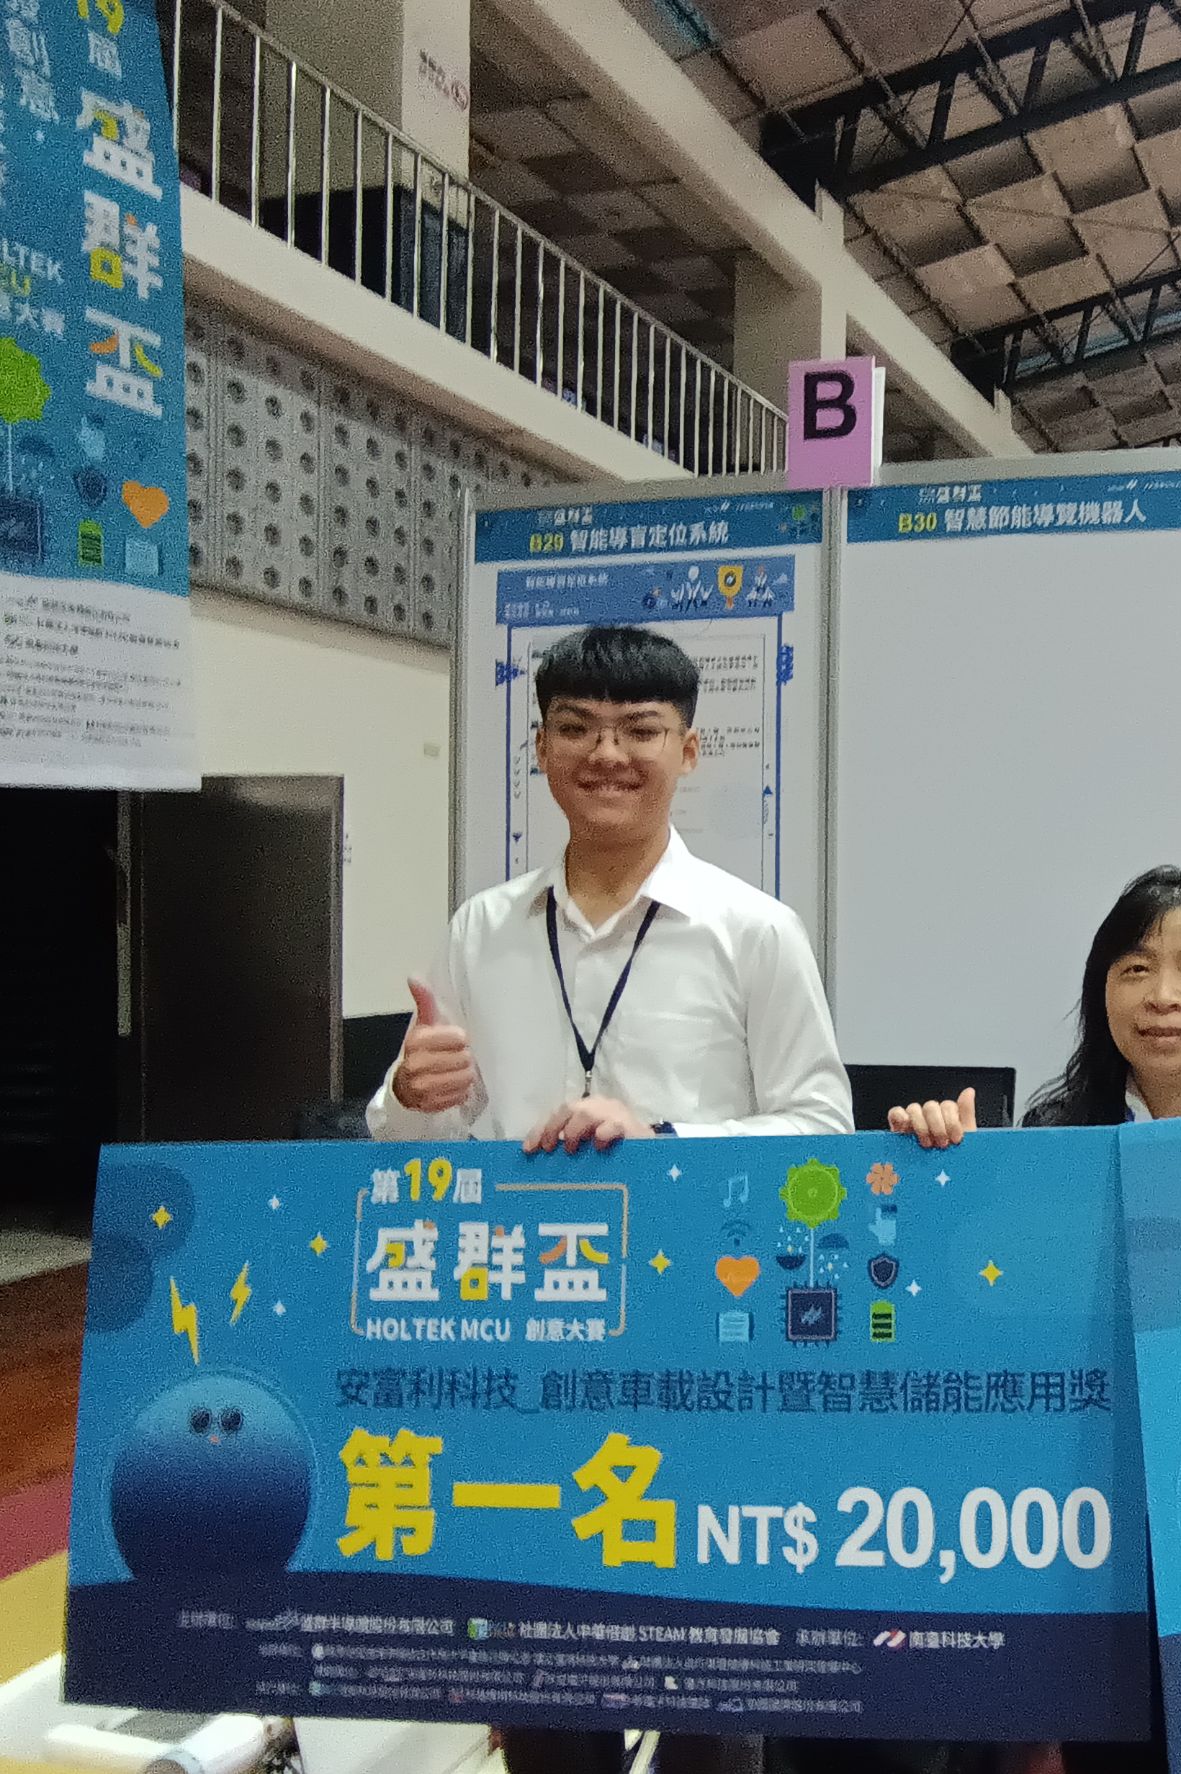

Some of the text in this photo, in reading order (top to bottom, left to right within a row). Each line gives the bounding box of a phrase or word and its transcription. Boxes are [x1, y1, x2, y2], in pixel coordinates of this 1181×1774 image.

[803, 369, 857, 440] B
[898, 512, 938, 533] B30
[371, 1158, 482, 1204] 第19屆
[366, 1219, 609, 1301] 盛群盃
[366, 1318, 606, 1342] HOLTEK MCU 創意大賽
[336, 1427, 1112, 1584] 第一名 NT$ 20,000
